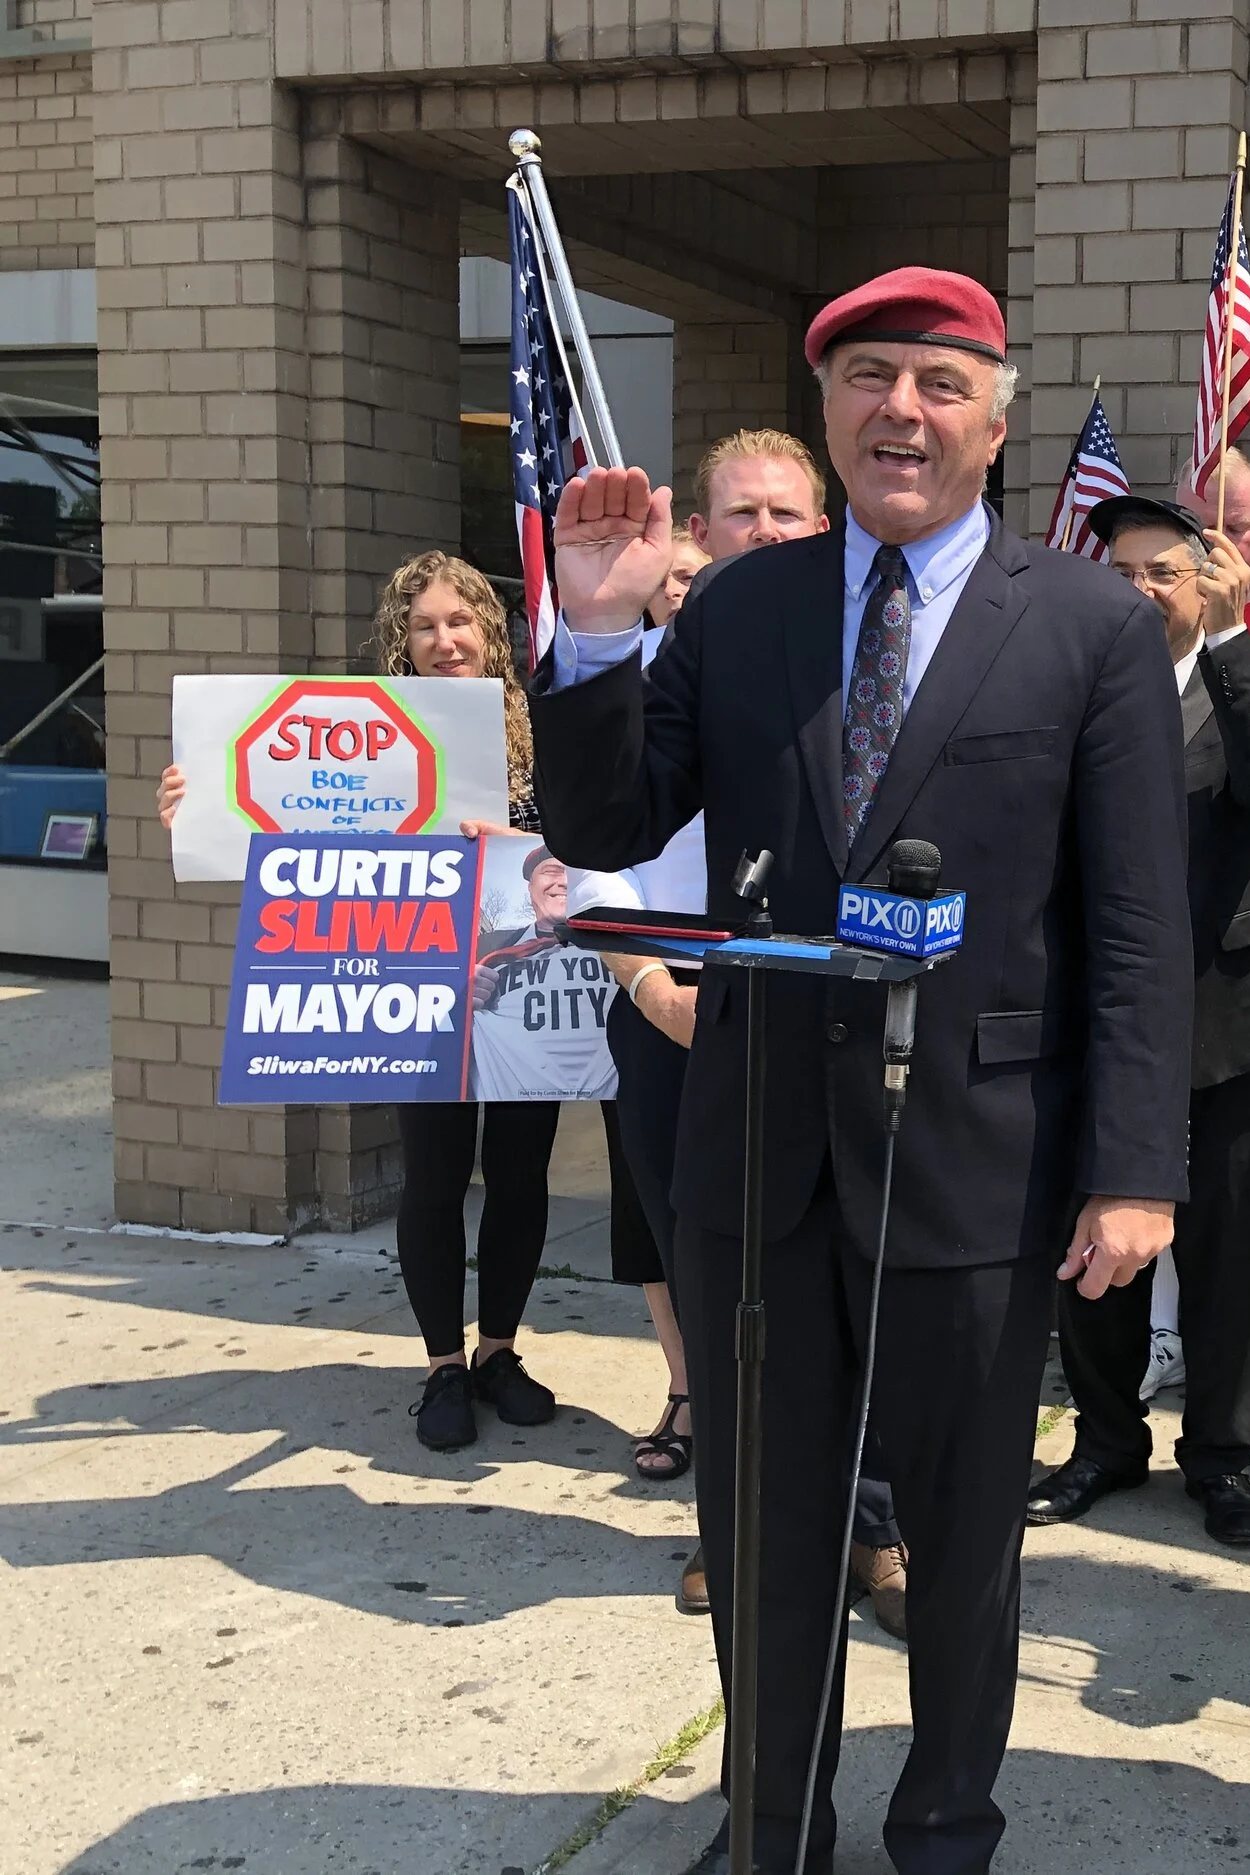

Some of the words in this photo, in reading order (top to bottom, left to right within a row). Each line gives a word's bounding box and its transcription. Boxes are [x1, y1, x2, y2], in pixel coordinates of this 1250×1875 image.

[268, 715, 398, 762] STOP
[312, 770, 369, 791] BOE
[281, 794, 407, 813] CONFLICTS
[332, 815, 362, 825] OF
[259, 847, 462, 898] CURTIS
[254, 900, 459, 953] SLIWA
[841, 892, 895, 931] PIX
[926, 902, 953, 937] PIX
[880, 937, 900, 948] VERY
[899, 941, 917, 952] OWN
[332, 957, 381, 977] FOR
[242, 983, 456, 1033] MAYOR
[523, 988, 608, 1031] CITY
[247, 1056, 438, 1076] SliwaForNY.com
